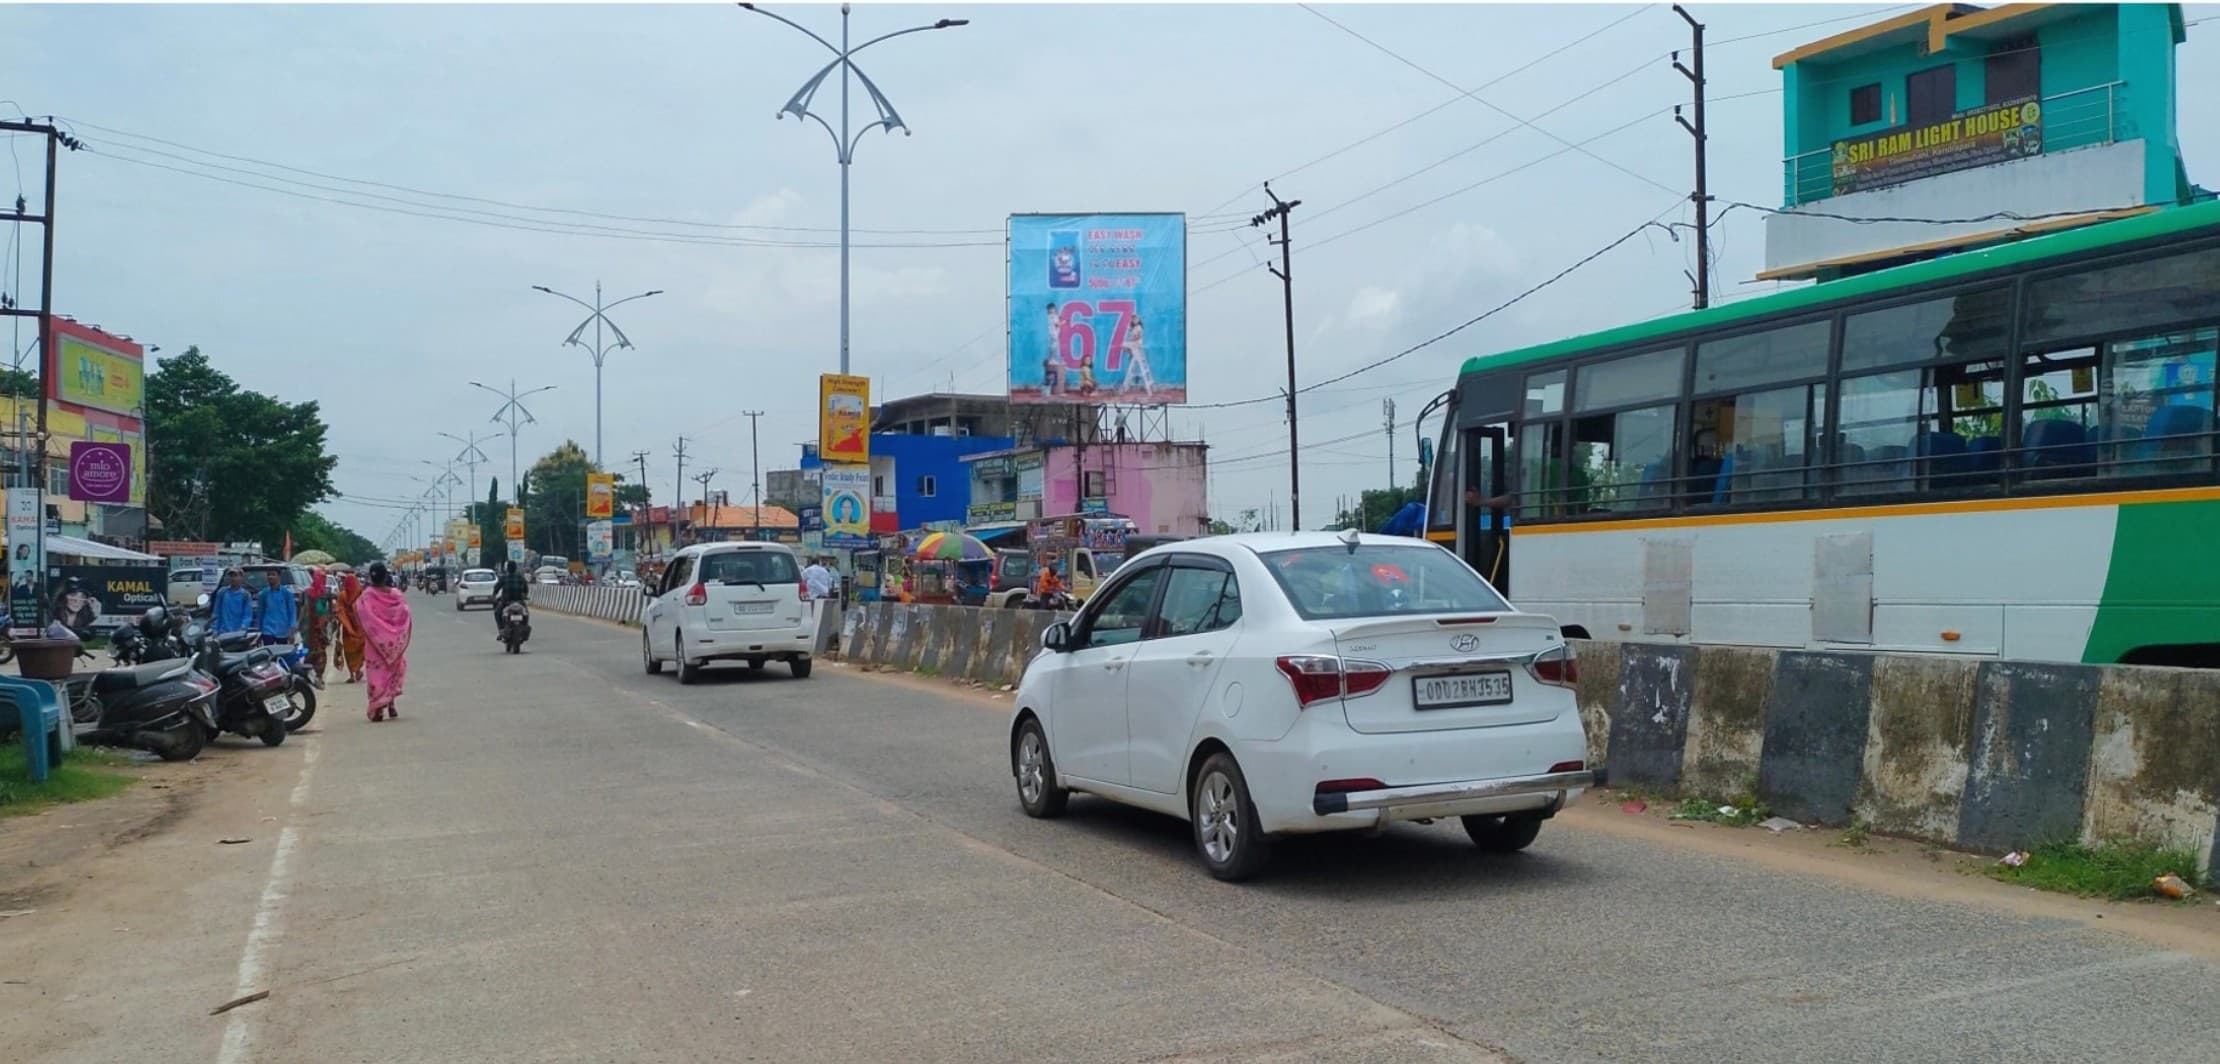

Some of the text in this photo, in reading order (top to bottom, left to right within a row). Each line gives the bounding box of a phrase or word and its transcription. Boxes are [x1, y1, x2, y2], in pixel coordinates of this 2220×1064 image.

[1848, 143, 1875, 164] SRI
[1878, 132, 1912, 158] RAM
[1915, 120, 1961, 149] LIGHT
[1965, 107, 2021, 137] HOUSE
[1088, 230, 1143, 240] EASY WASH
[1058, 300, 1137, 371] 67
[106, 580, 153, 592] KAMAL
[123, 592, 158, 604] Optical
